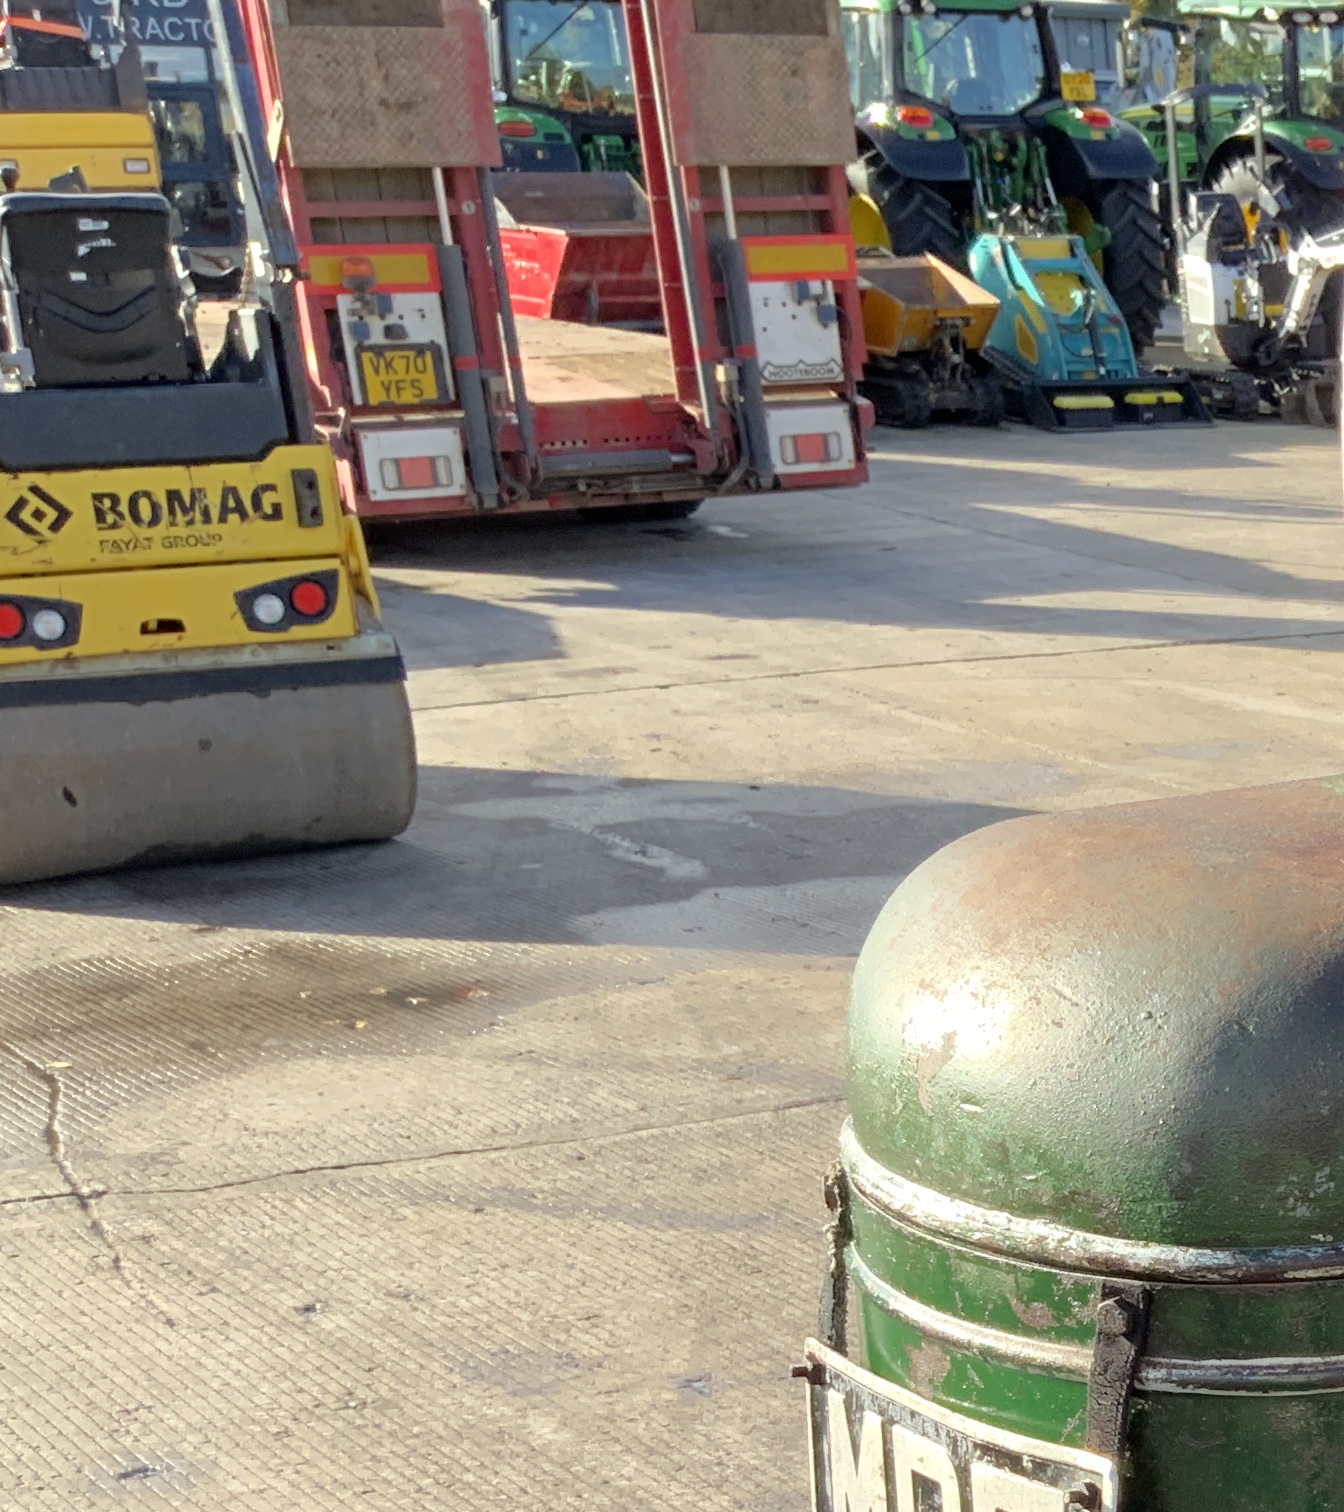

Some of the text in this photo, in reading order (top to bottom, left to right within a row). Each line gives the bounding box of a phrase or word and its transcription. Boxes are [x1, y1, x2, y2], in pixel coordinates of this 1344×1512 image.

[381, 379, 425, 399] YFS
[91, 483, 284, 531] BOMAG
[100, 533, 224, 554] FAYAT GROUP
